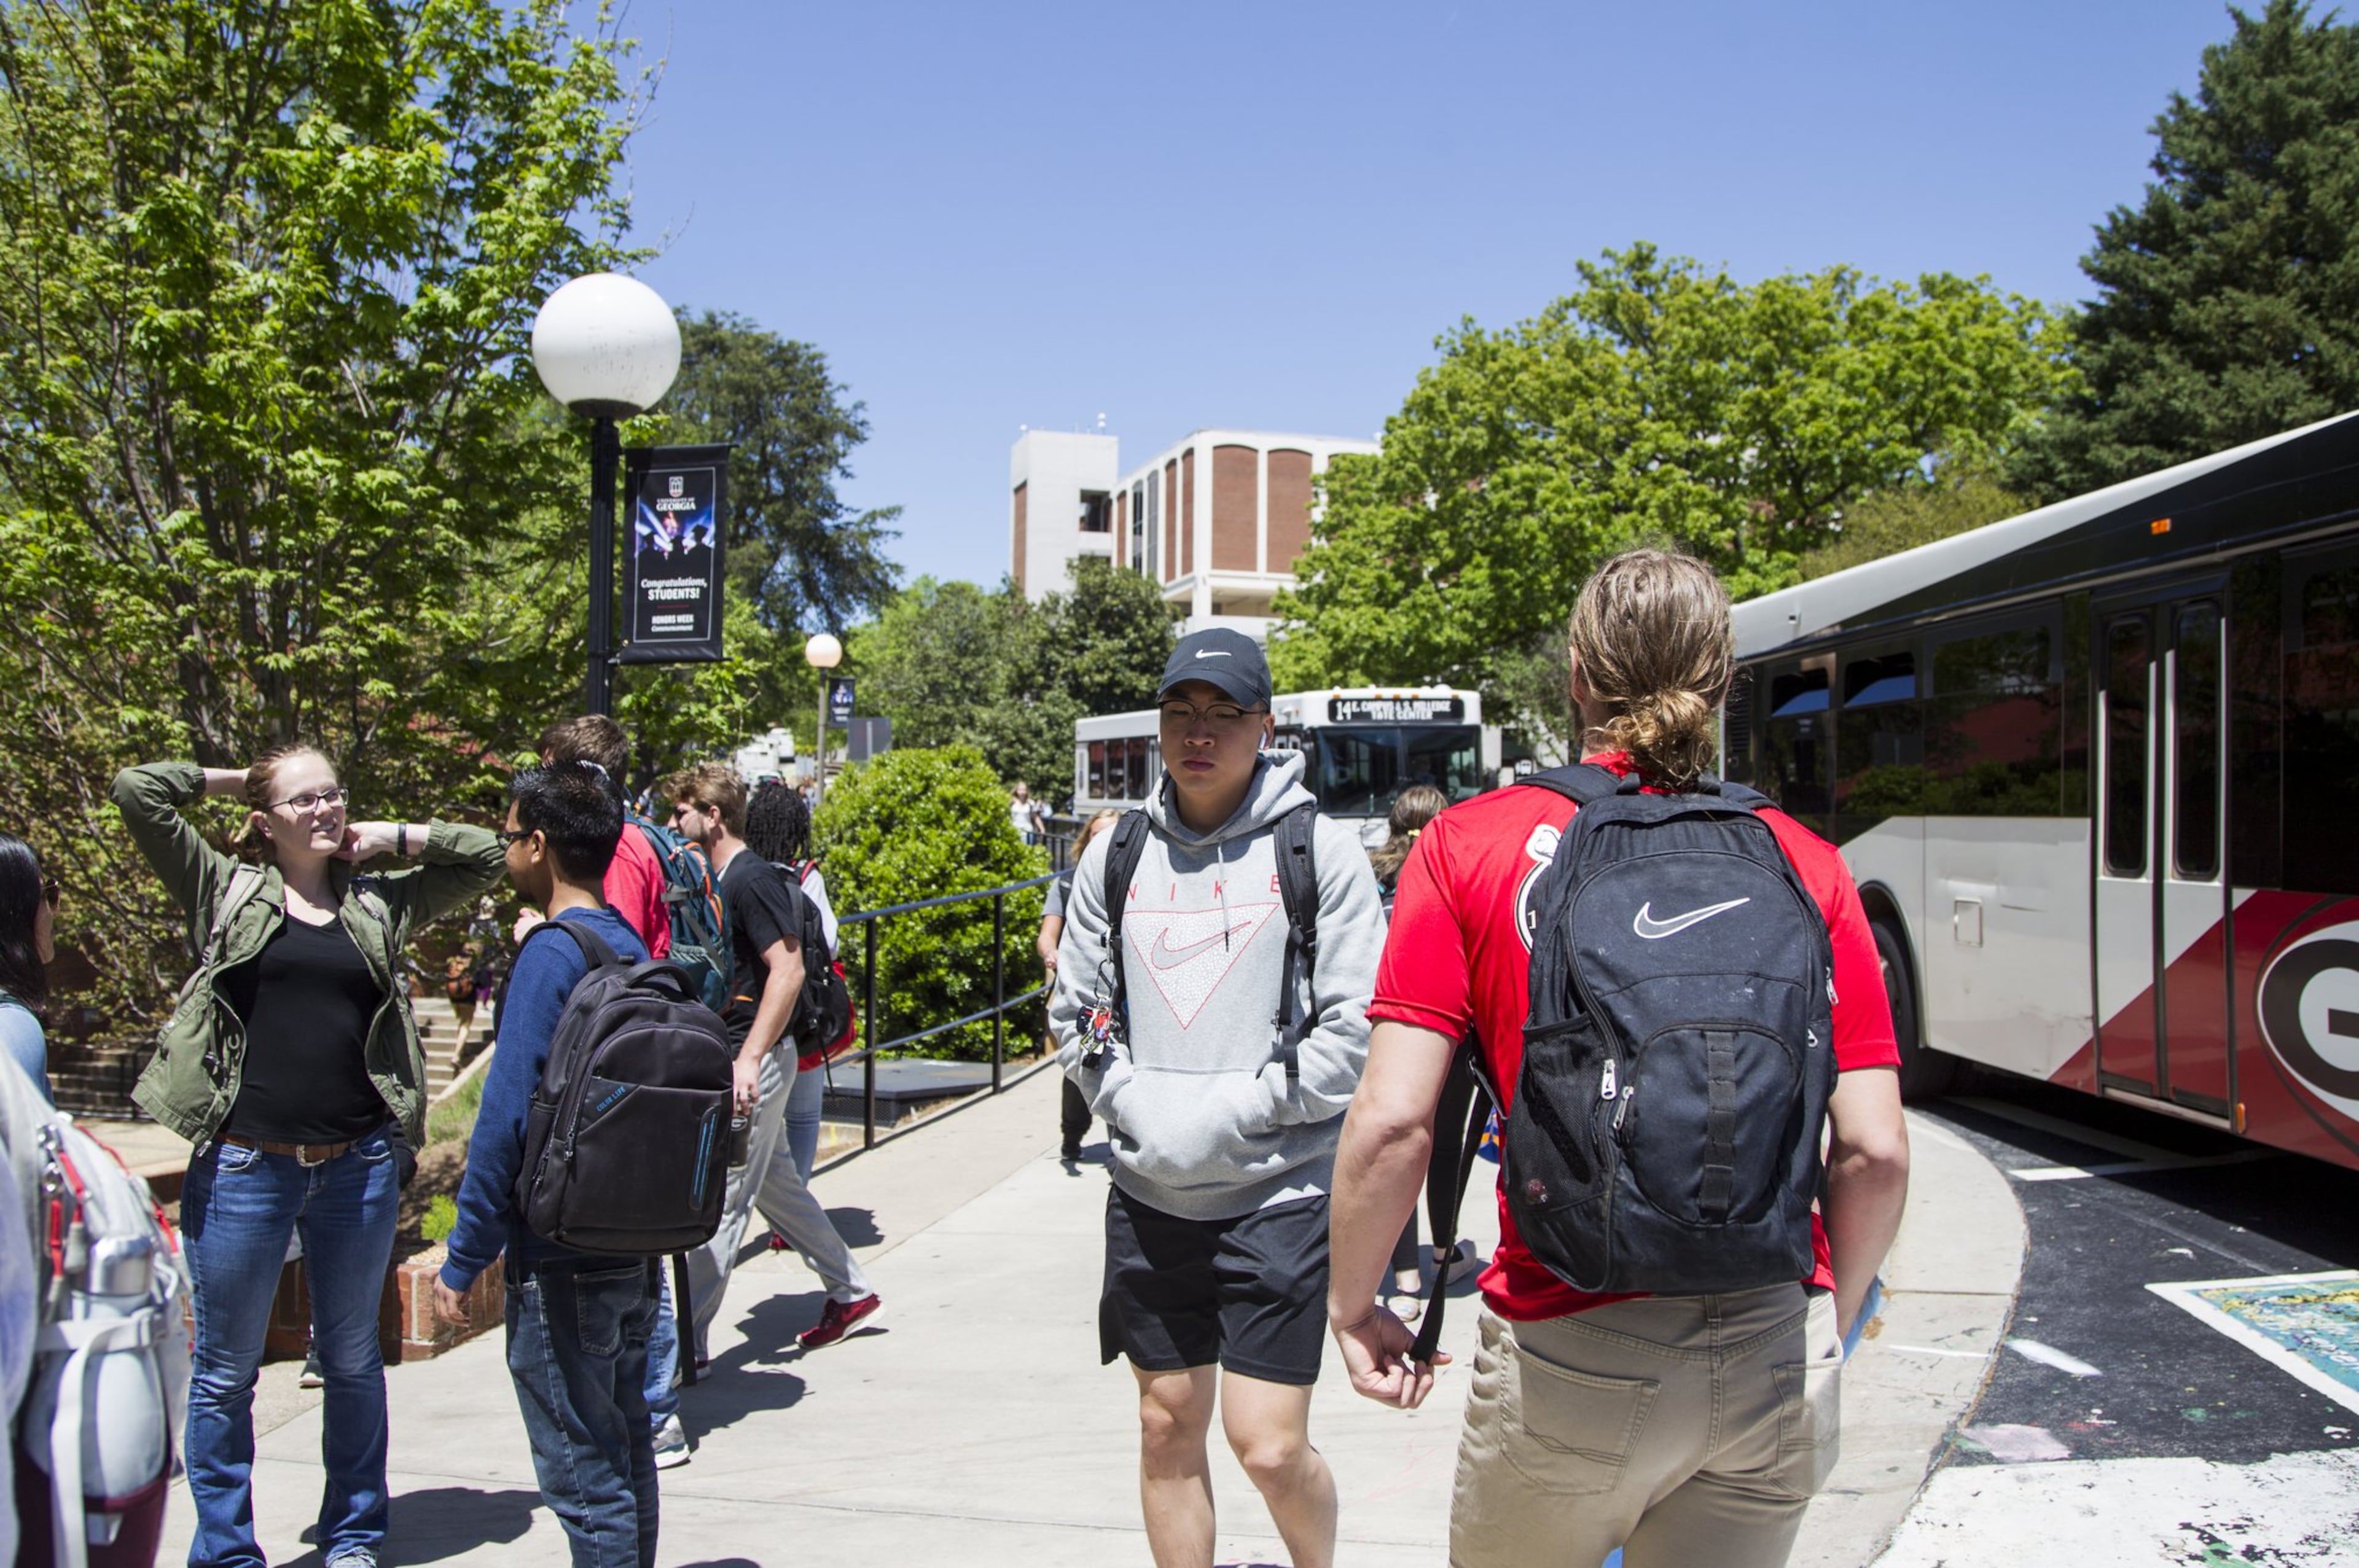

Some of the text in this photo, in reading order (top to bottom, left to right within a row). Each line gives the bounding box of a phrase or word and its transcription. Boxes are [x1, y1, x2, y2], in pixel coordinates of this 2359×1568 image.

[655, 501, 696, 512] GEORGIA
[641, 577, 708, 588] Congratulations,
[647, 587, 700, 601] STUDENTS!
[1336, 701, 1352, 720] 14
